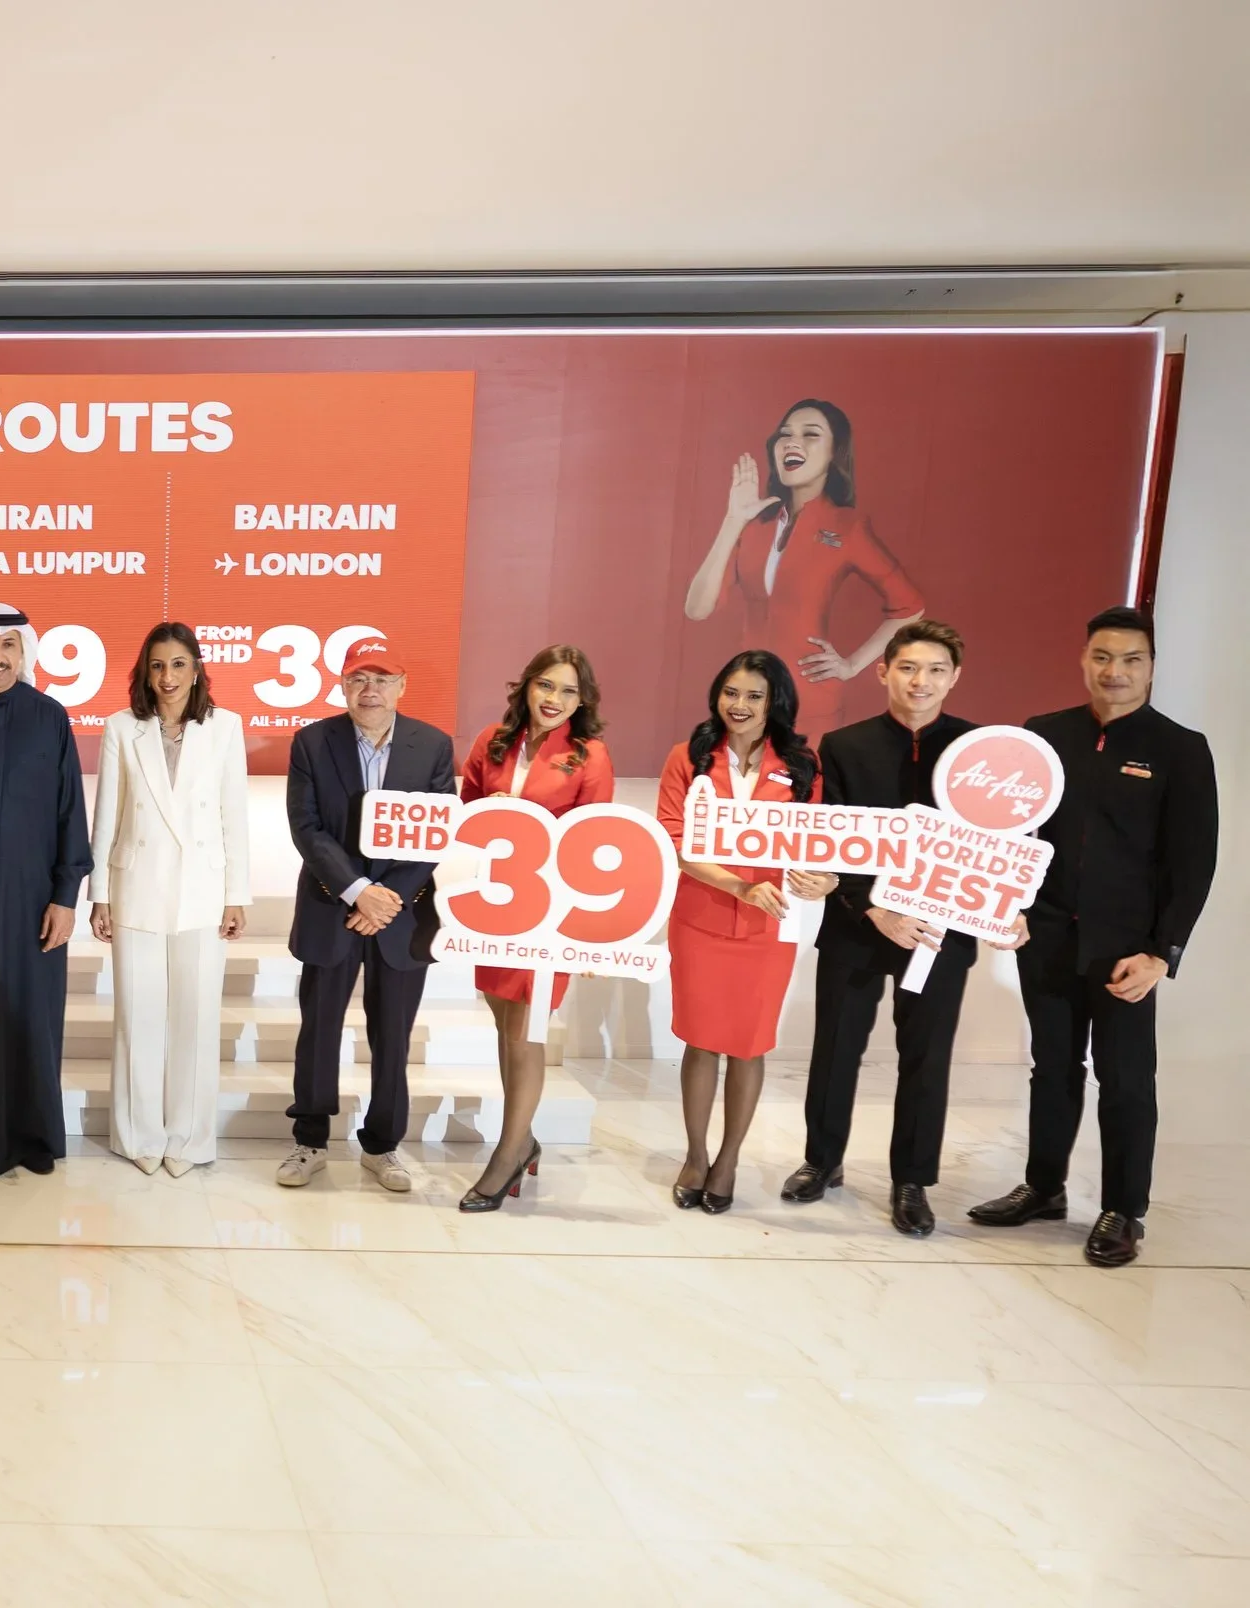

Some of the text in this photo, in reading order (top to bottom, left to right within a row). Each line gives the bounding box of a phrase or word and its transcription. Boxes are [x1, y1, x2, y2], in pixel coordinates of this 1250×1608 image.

[235, 504, 397, 531] BAHRAIN
[18, 551, 146, 575] LUMPUR
[245, 553, 381, 576] LONDON
[195, 625, 252, 640] FROM
[35, 624, 106, 708] 9
[249, 715, 288, 727] All-in
[374, 802, 450, 823] FROM
[716, 806, 909, 834] FLY DIRECT TO
[372, 823, 449, 851] BHD
[714, 827, 907, 869] LONDON
[950, 824, 1001, 851] WITH
[1006, 840, 1042, 863] THE
[448, 809, 664, 943] 39
[883, 890, 1011, 936] LOW-COST AIRLINE
[505, 943, 554, 962] Fare,
[562, 946, 657, 972] One-Way
